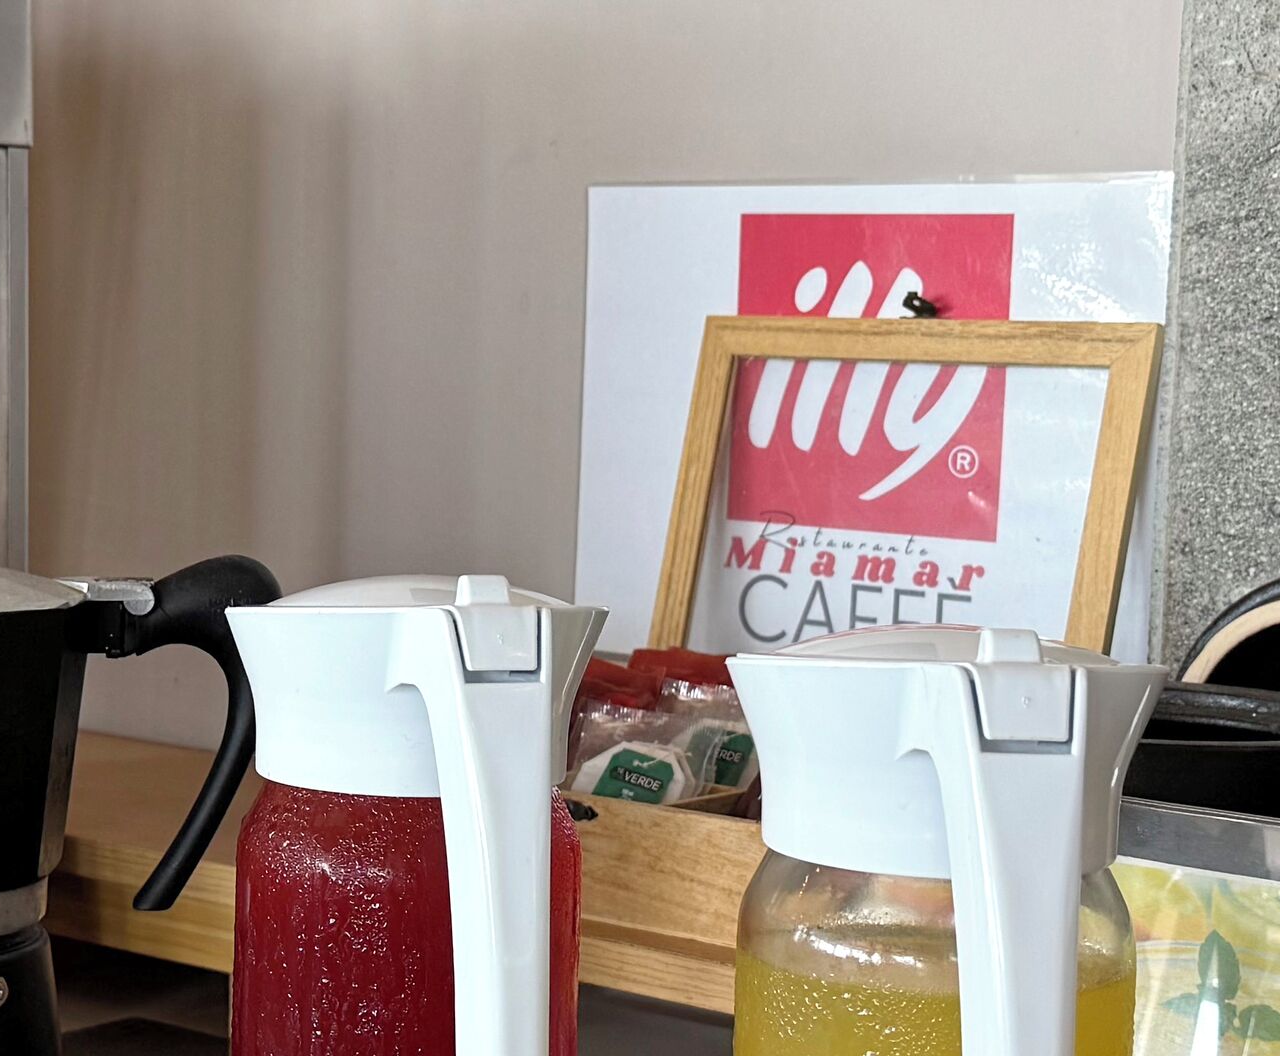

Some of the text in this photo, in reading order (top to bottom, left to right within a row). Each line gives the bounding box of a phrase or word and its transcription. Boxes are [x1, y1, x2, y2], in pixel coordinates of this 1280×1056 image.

[748, 260, 988, 501] illy
[757, 510, 929, 557] Restaurante
[723, 535, 986, 592] Miamar
[624, 770, 662, 792] VERDE
